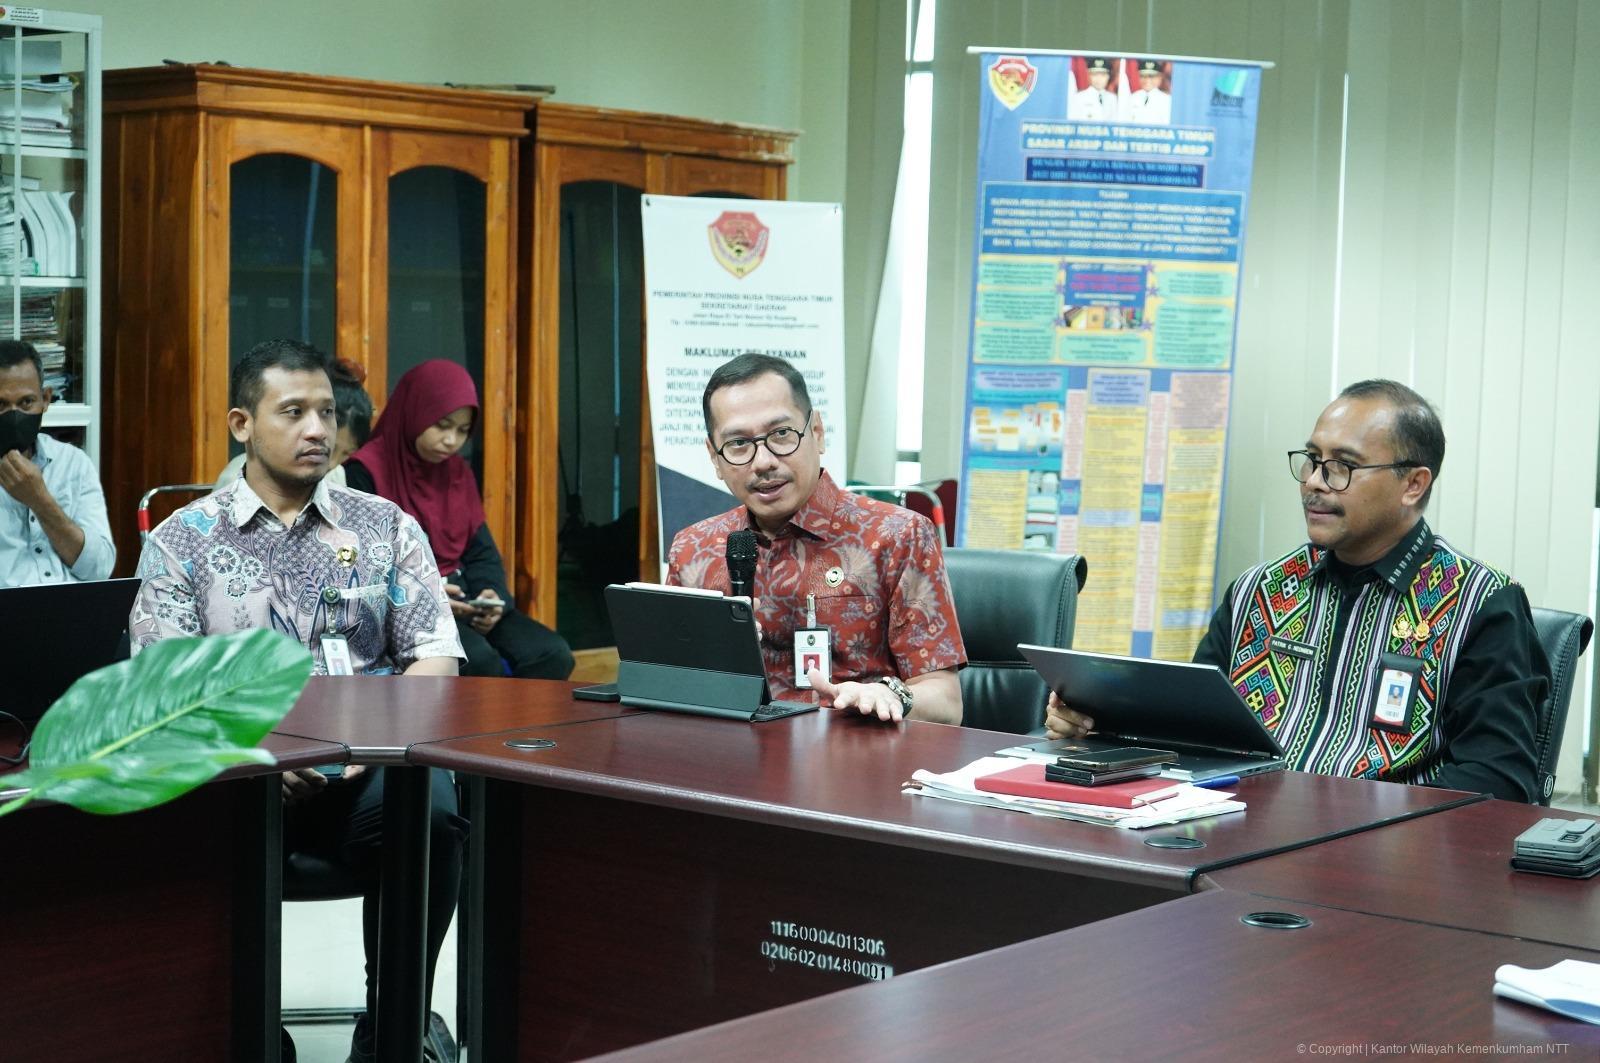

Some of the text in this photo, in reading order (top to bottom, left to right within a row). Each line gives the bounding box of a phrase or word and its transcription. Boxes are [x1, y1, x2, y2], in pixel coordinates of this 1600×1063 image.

[1077, 126, 1110, 137] NUSA
[1111, 126, 1175, 140] TENGGARA
[684, 347, 742, 358] MAKLUMAT
[770, 920, 886, 957] 11160004011306
